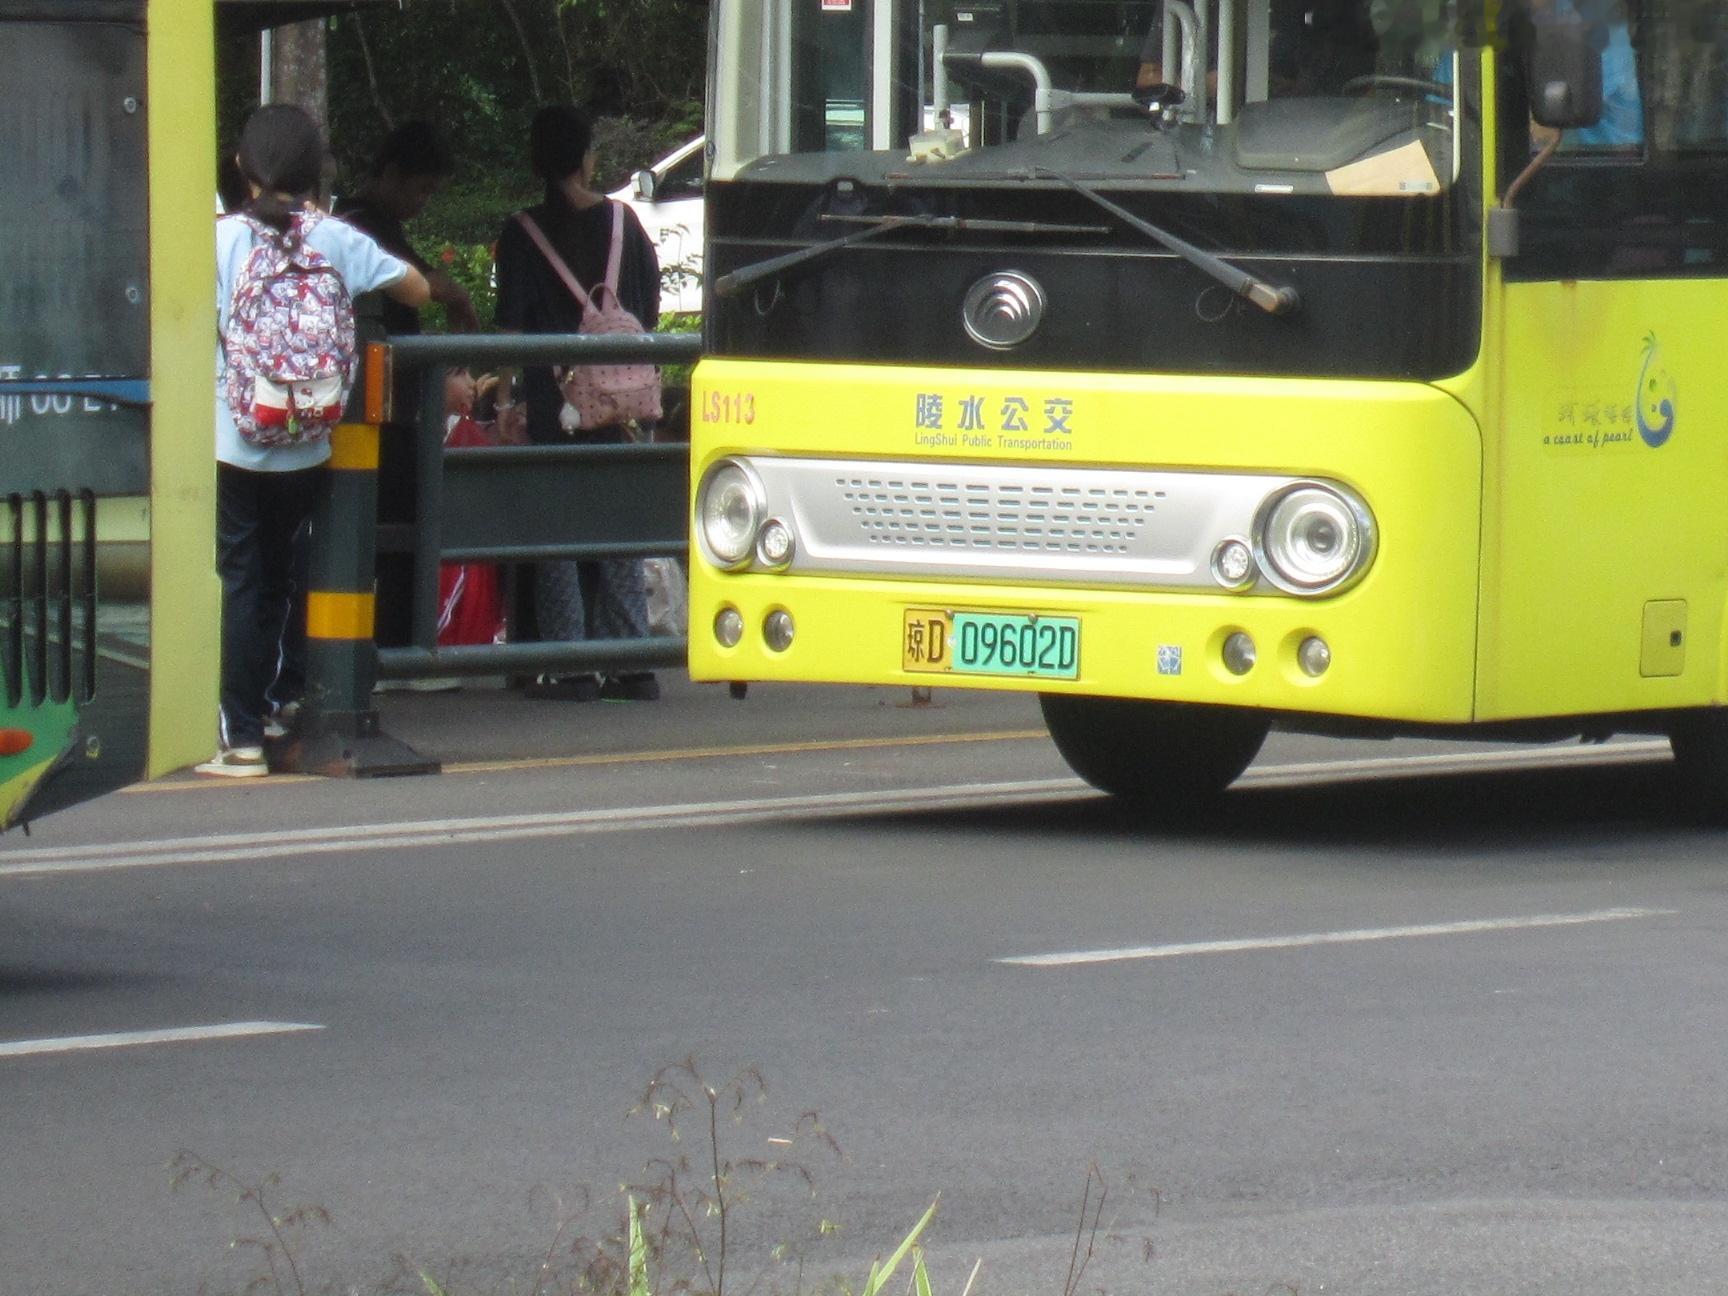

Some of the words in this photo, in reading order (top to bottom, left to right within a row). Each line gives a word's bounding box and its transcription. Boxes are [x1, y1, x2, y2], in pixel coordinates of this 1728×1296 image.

[701, 390, 756, 426] LS113
[915, 392, 1074, 435] 陵水公交
[914, 431, 958, 448] LingShui
[962, 433, 992, 448] Public
[997, 434, 1073, 451] Transportation
[1587, 429, 1600, 448] of
[1601, 427, 1634, 448] pearl
[961, 620, 1076, 671] 09602D
